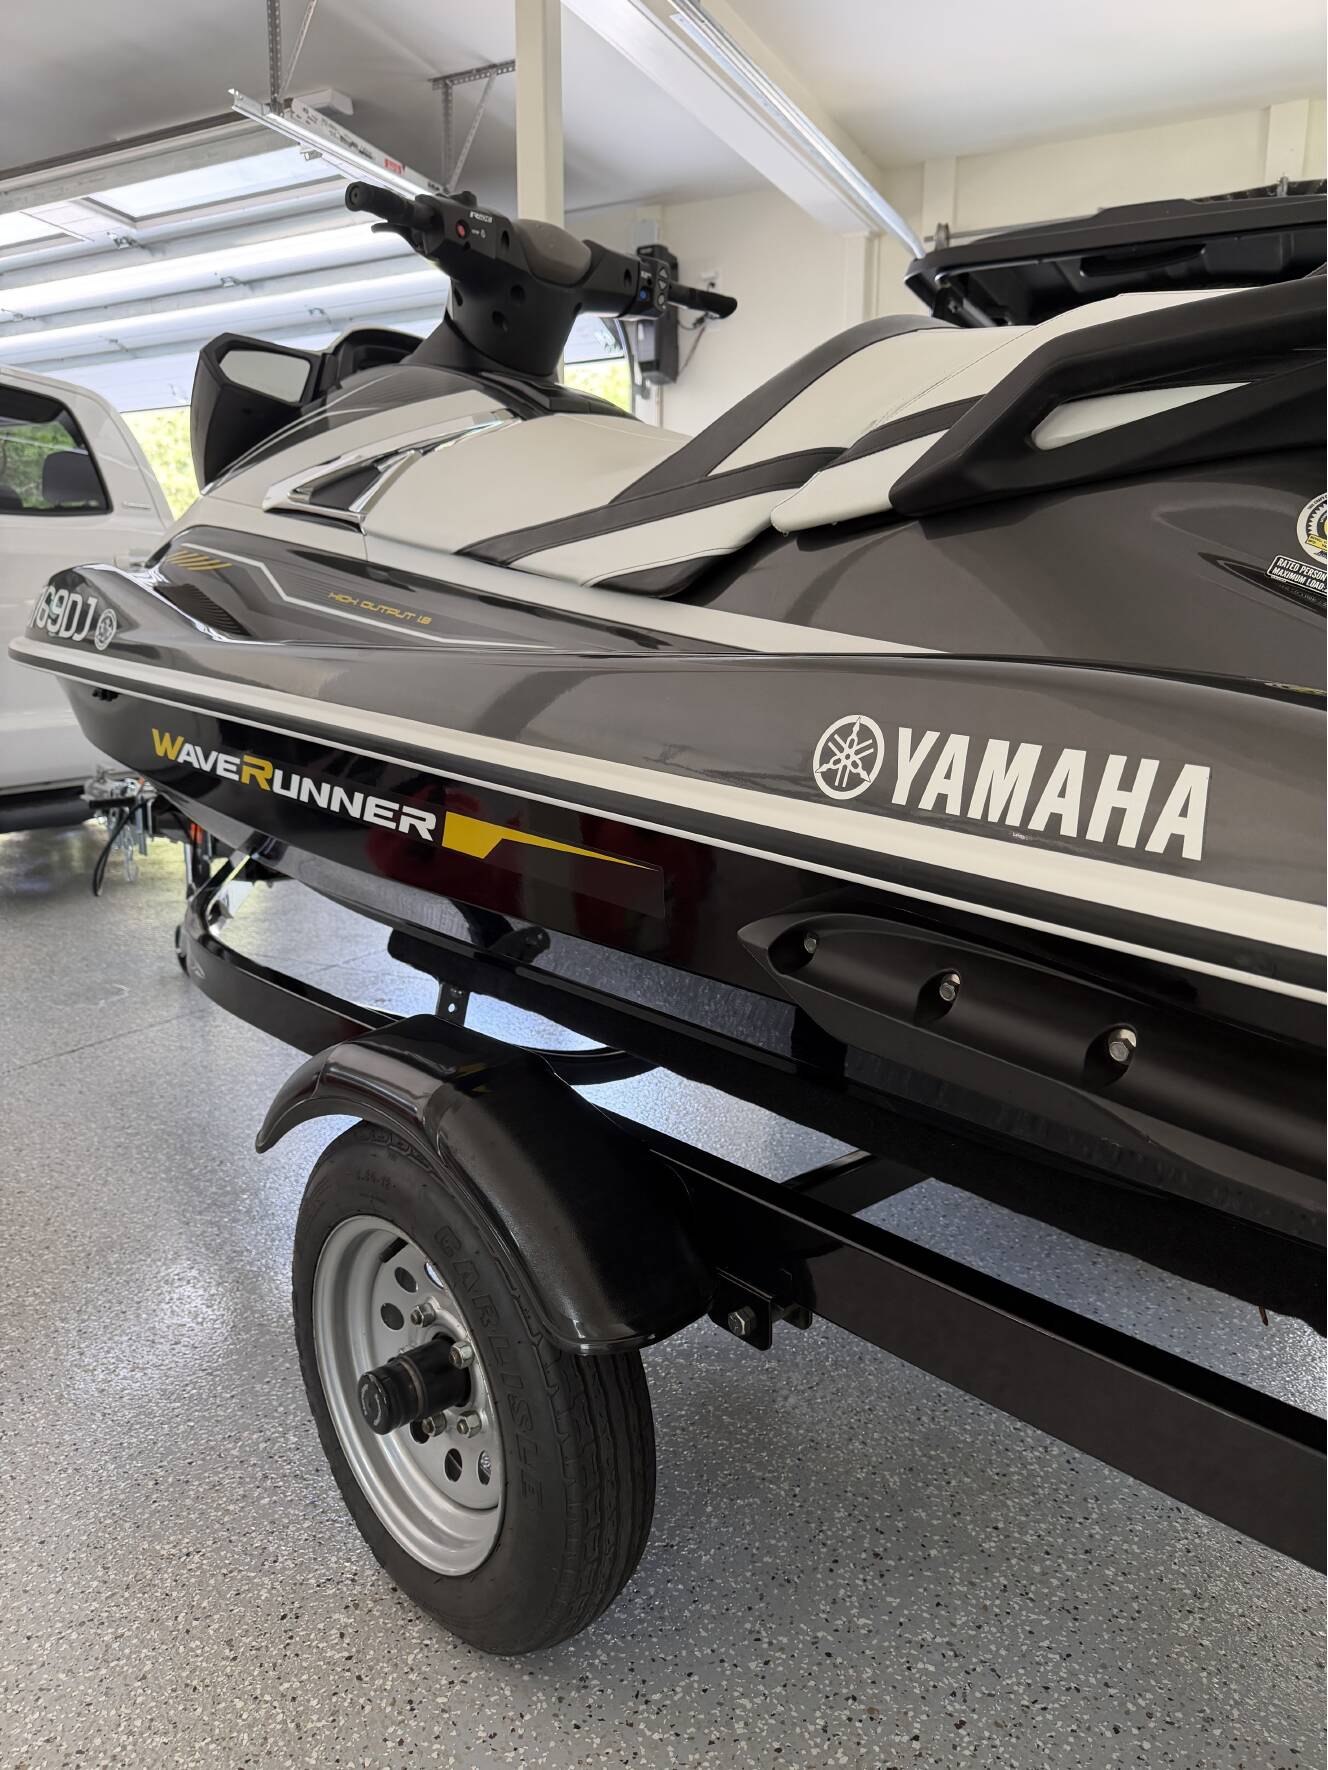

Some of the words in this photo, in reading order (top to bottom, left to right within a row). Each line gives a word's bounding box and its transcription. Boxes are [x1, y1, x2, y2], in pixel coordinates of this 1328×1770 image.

[1277, 558, 1300, 572] RATED
[1271, 567, 1307, 584] MAXIMUM
[360, 600, 416, 620] OUTPUT
[891, 727, 1211, 861] YAMAHA
